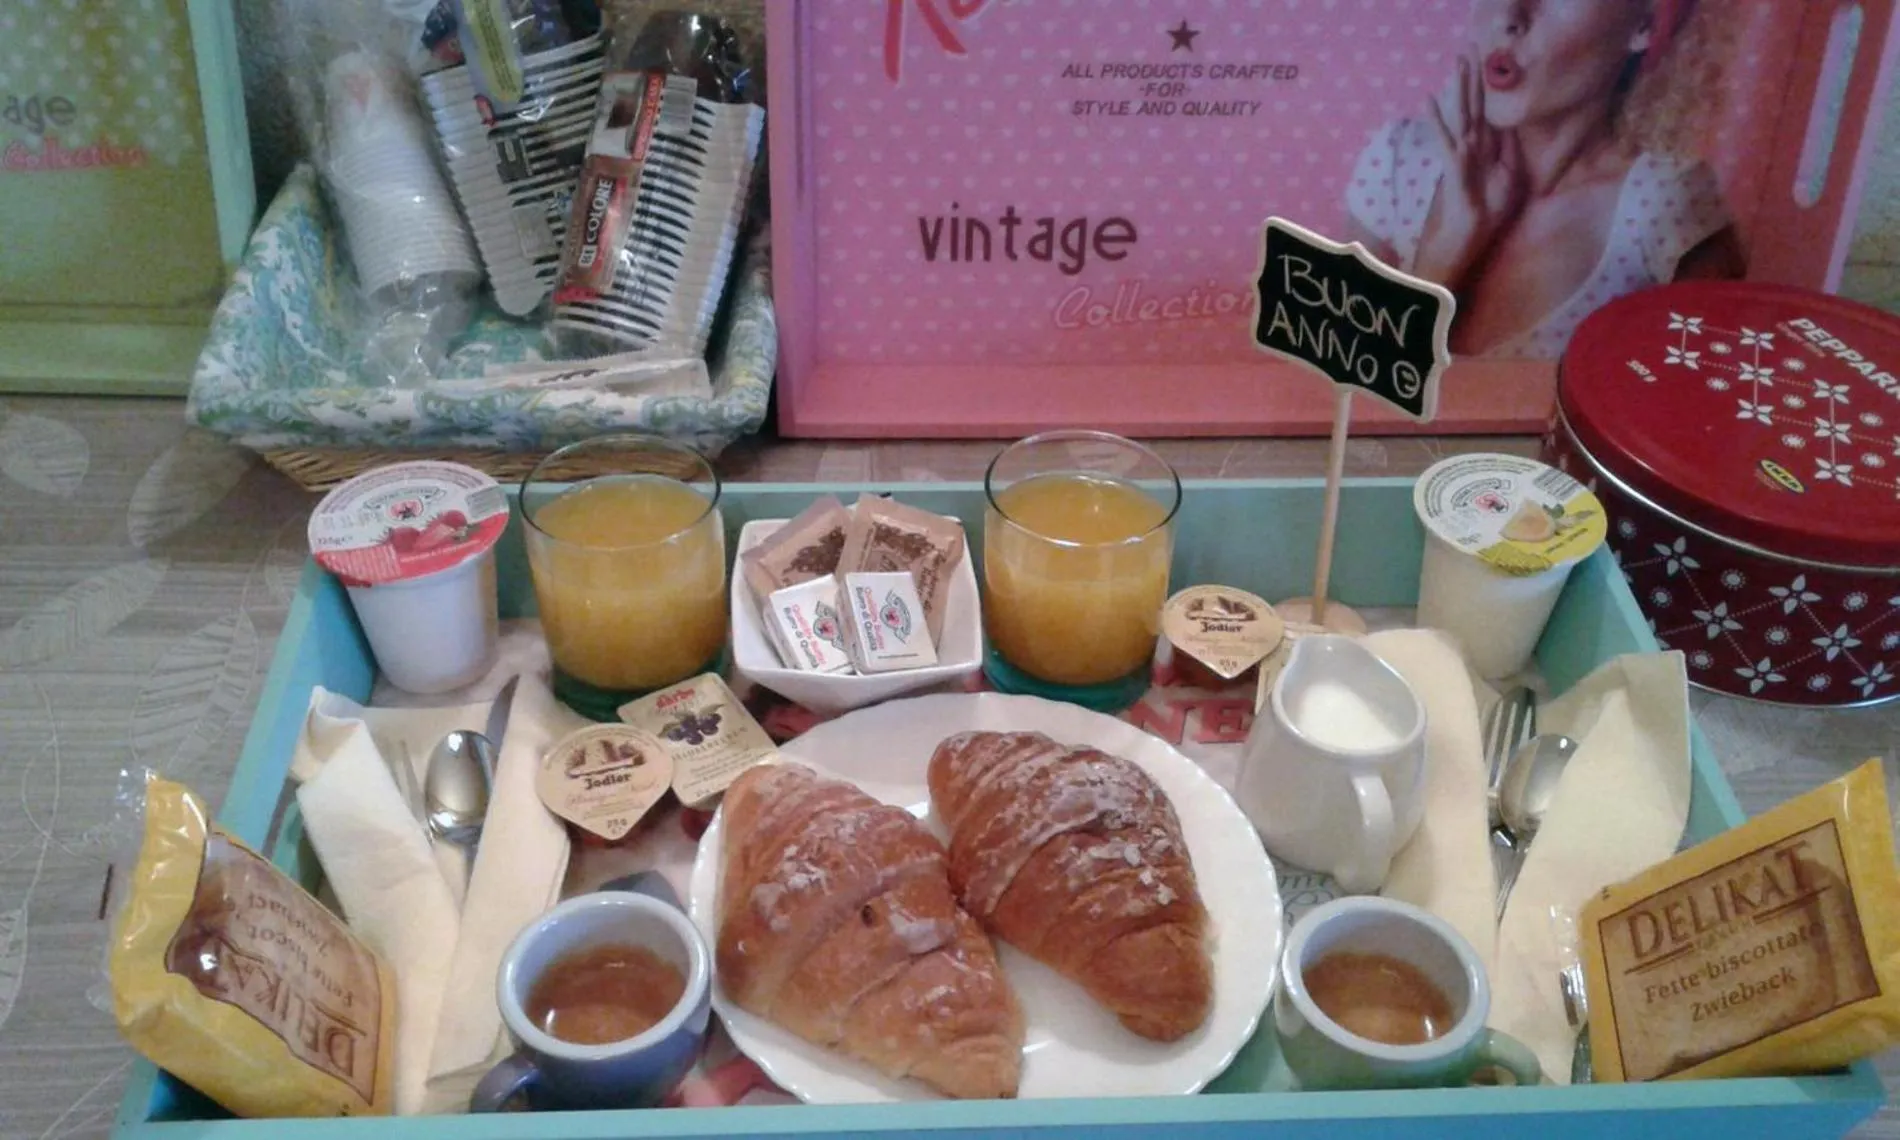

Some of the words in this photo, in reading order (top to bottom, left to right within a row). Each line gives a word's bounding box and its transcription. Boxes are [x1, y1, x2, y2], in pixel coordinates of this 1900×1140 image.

[1062, 63, 1094, 79] ALL
[1100, 63, 1203, 79] PRODUCTS
[1209, 63, 1298, 80] CRAFTED
[1072, 100, 1130, 116] STYLE
[1136, 100, 1175, 116] AND
[1182, 100, 1262, 118] QUALITY
[919, 202, 1138, 276] vintage
[1277, 253, 1420, 348] BUON
[1267, 301, 1379, 384] ANNO
[1200, 621, 1244, 633] Jodler
[584, 770, 633, 791] Jodler
[1627, 840, 1810, 960] DELIKAT
[1643, 972, 1701, 1004] Fette
[1704, 921, 1827, 980] biscottate
[1689, 966, 1797, 1023] Zwieback
